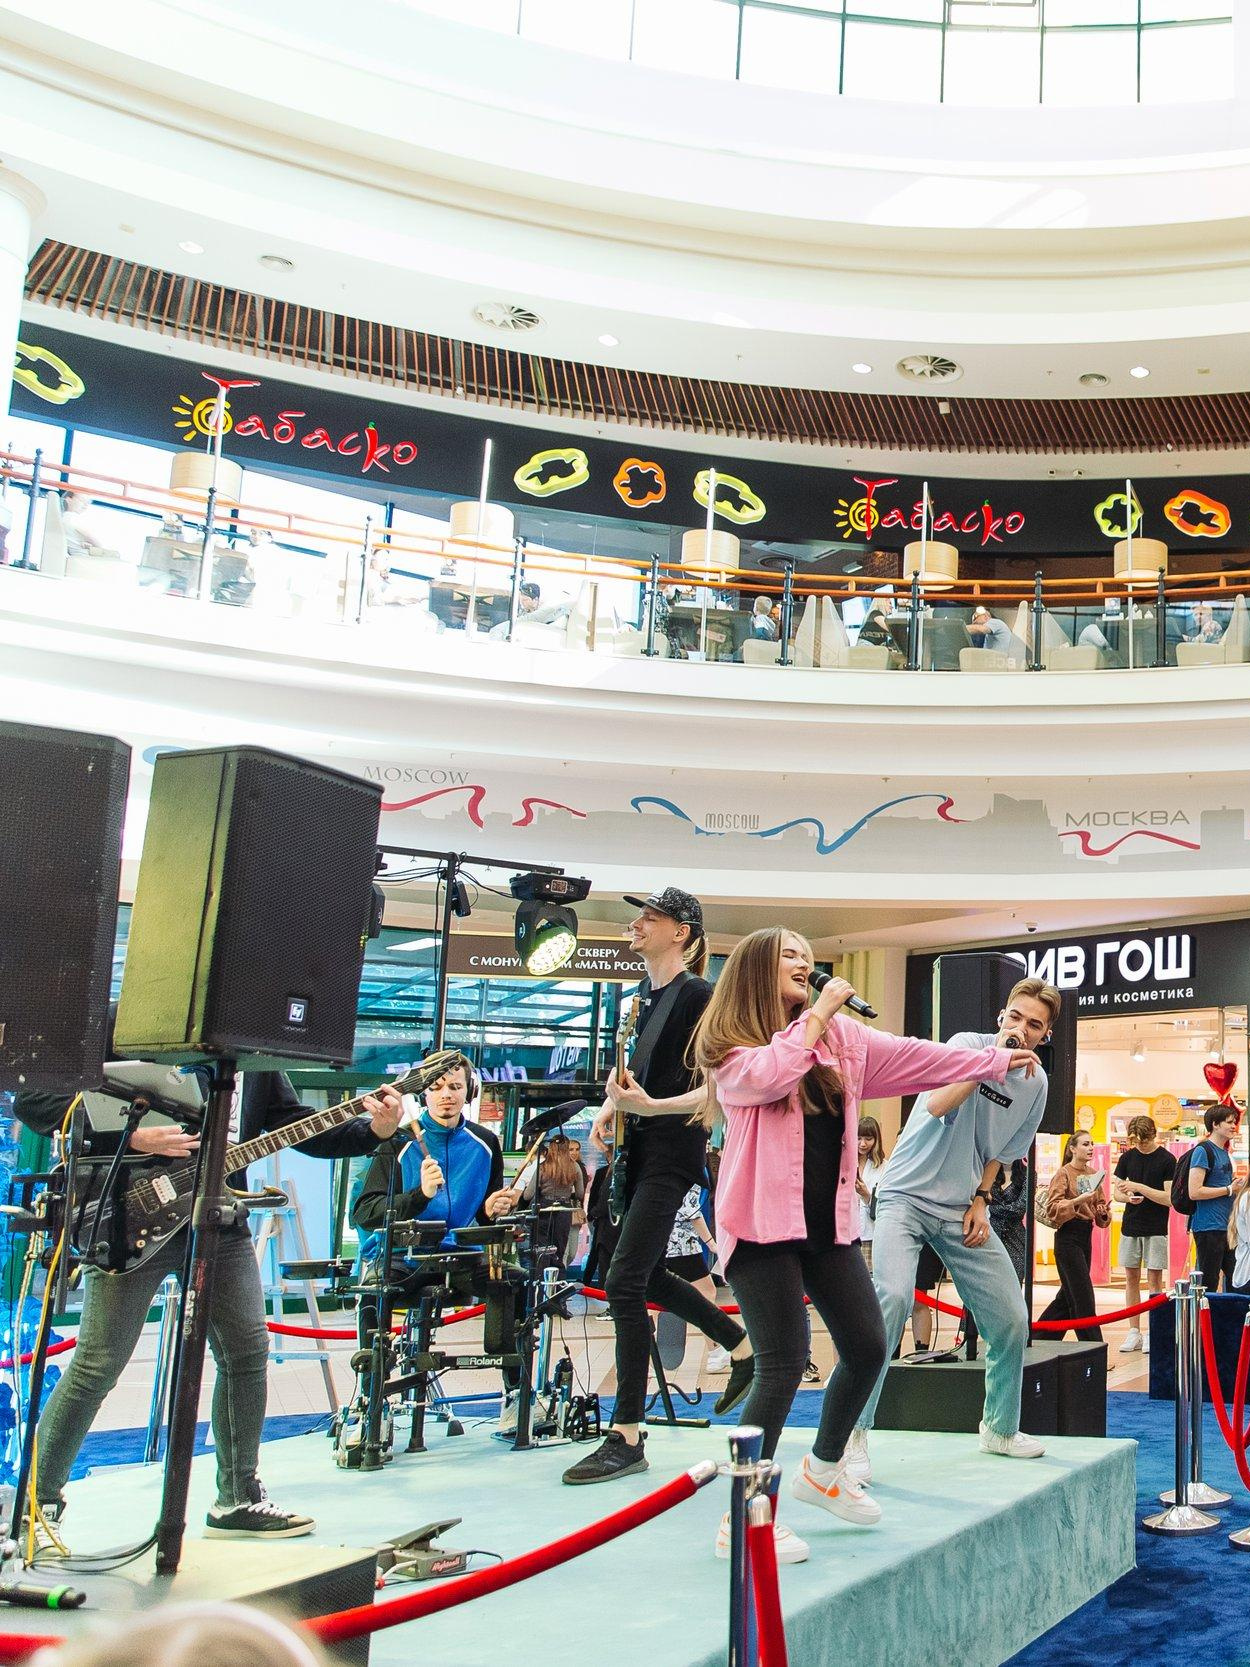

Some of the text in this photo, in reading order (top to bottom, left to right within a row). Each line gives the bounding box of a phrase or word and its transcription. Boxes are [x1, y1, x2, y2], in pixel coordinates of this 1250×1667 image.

[853, 476, 1025, 546] Табаско
[362, 765, 470, 785] MOSCOW
[704, 812, 760, 830] MOSCOW
[1064, 809, 1191, 828] МОСКВА
[577, 947, 620, 958] СКВЕРУ
[1095, 934, 1191, 986] ГОШ
[469, 956, 479, 967] С
[574, 960, 612, 971] «МАТЬ
[1099, 993, 1109, 1005] и
[1113, 986, 1195, 1004] косметика
[469, 1356, 503, 1366] Roland
